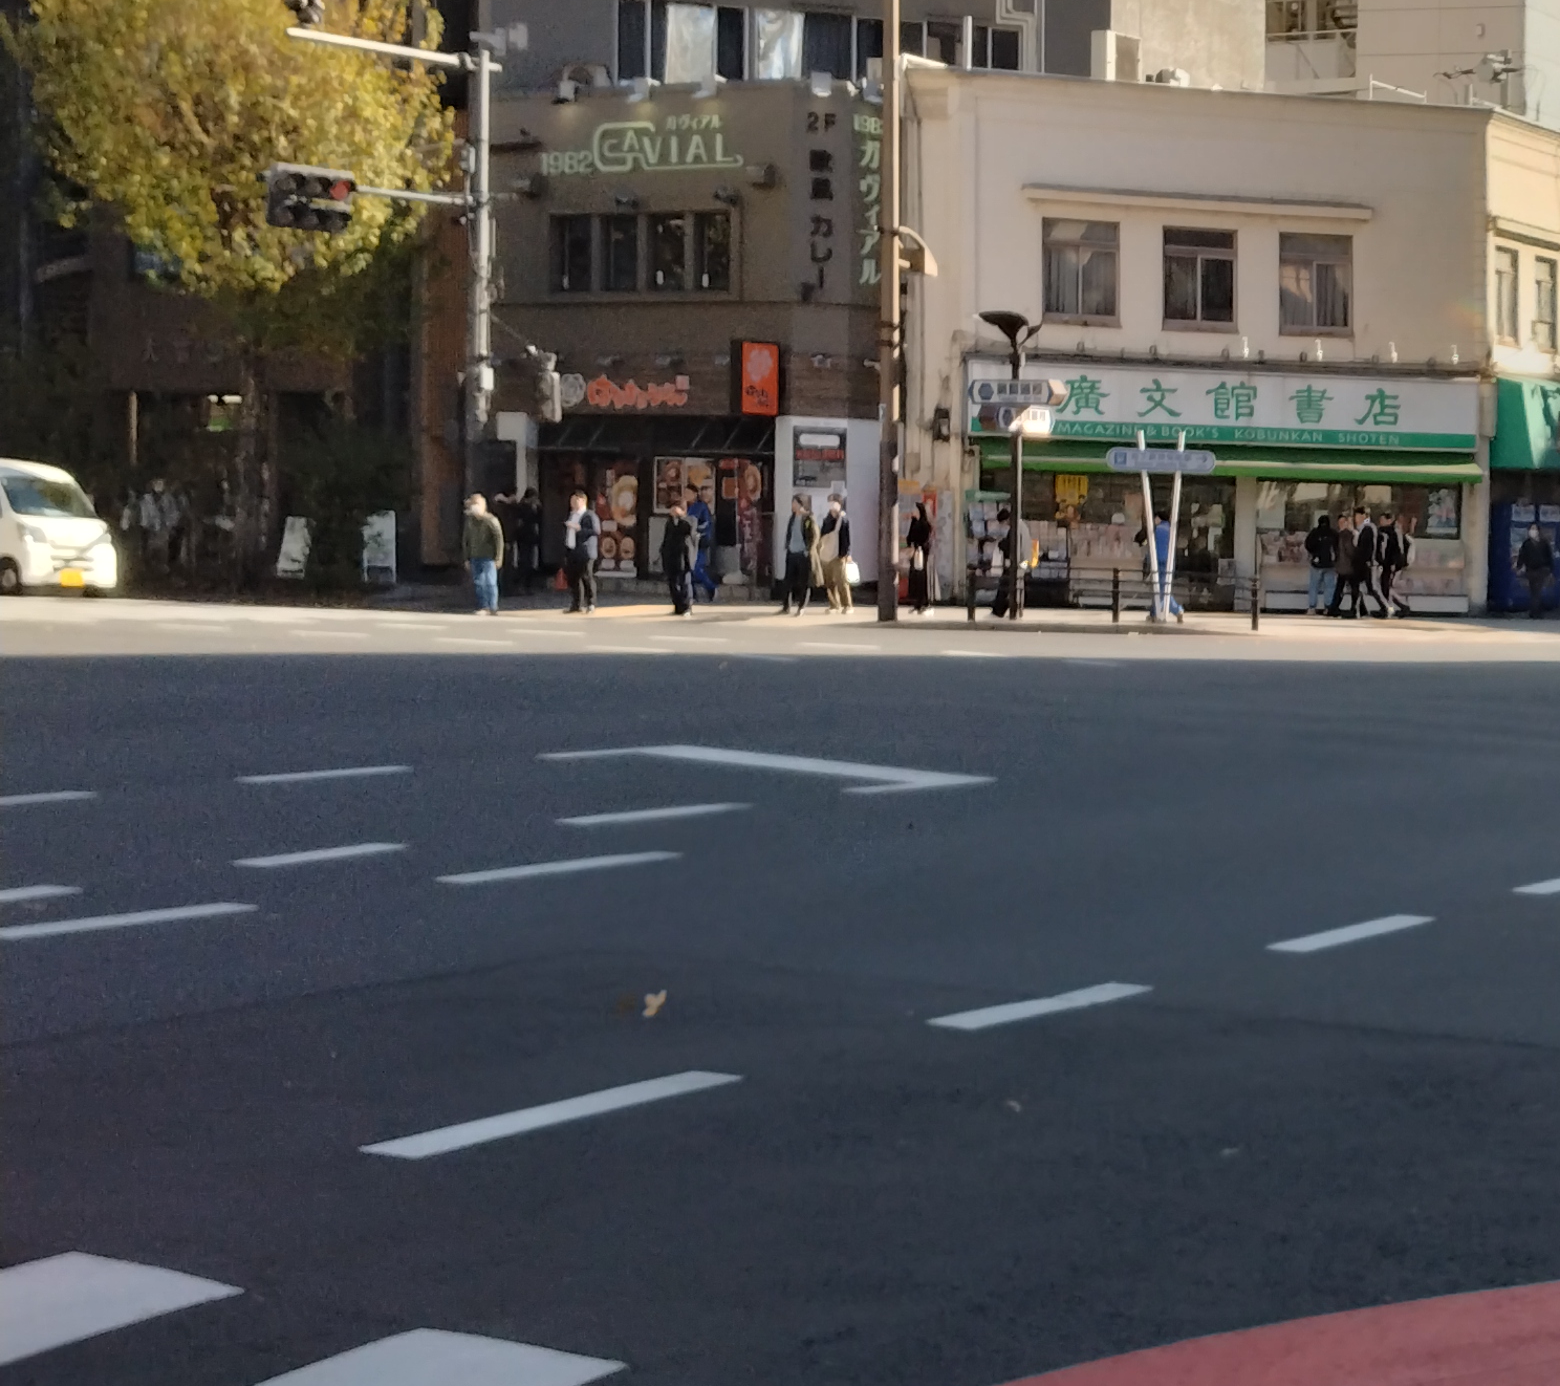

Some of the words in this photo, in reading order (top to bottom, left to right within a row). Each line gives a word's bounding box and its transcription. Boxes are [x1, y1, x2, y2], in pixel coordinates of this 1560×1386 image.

[1056, 375, 1402, 426] 廣文館書店
[1234, 428, 1323, 442] KOBUNKAN
[1338, 432, 1400, 445] SHOTEN
